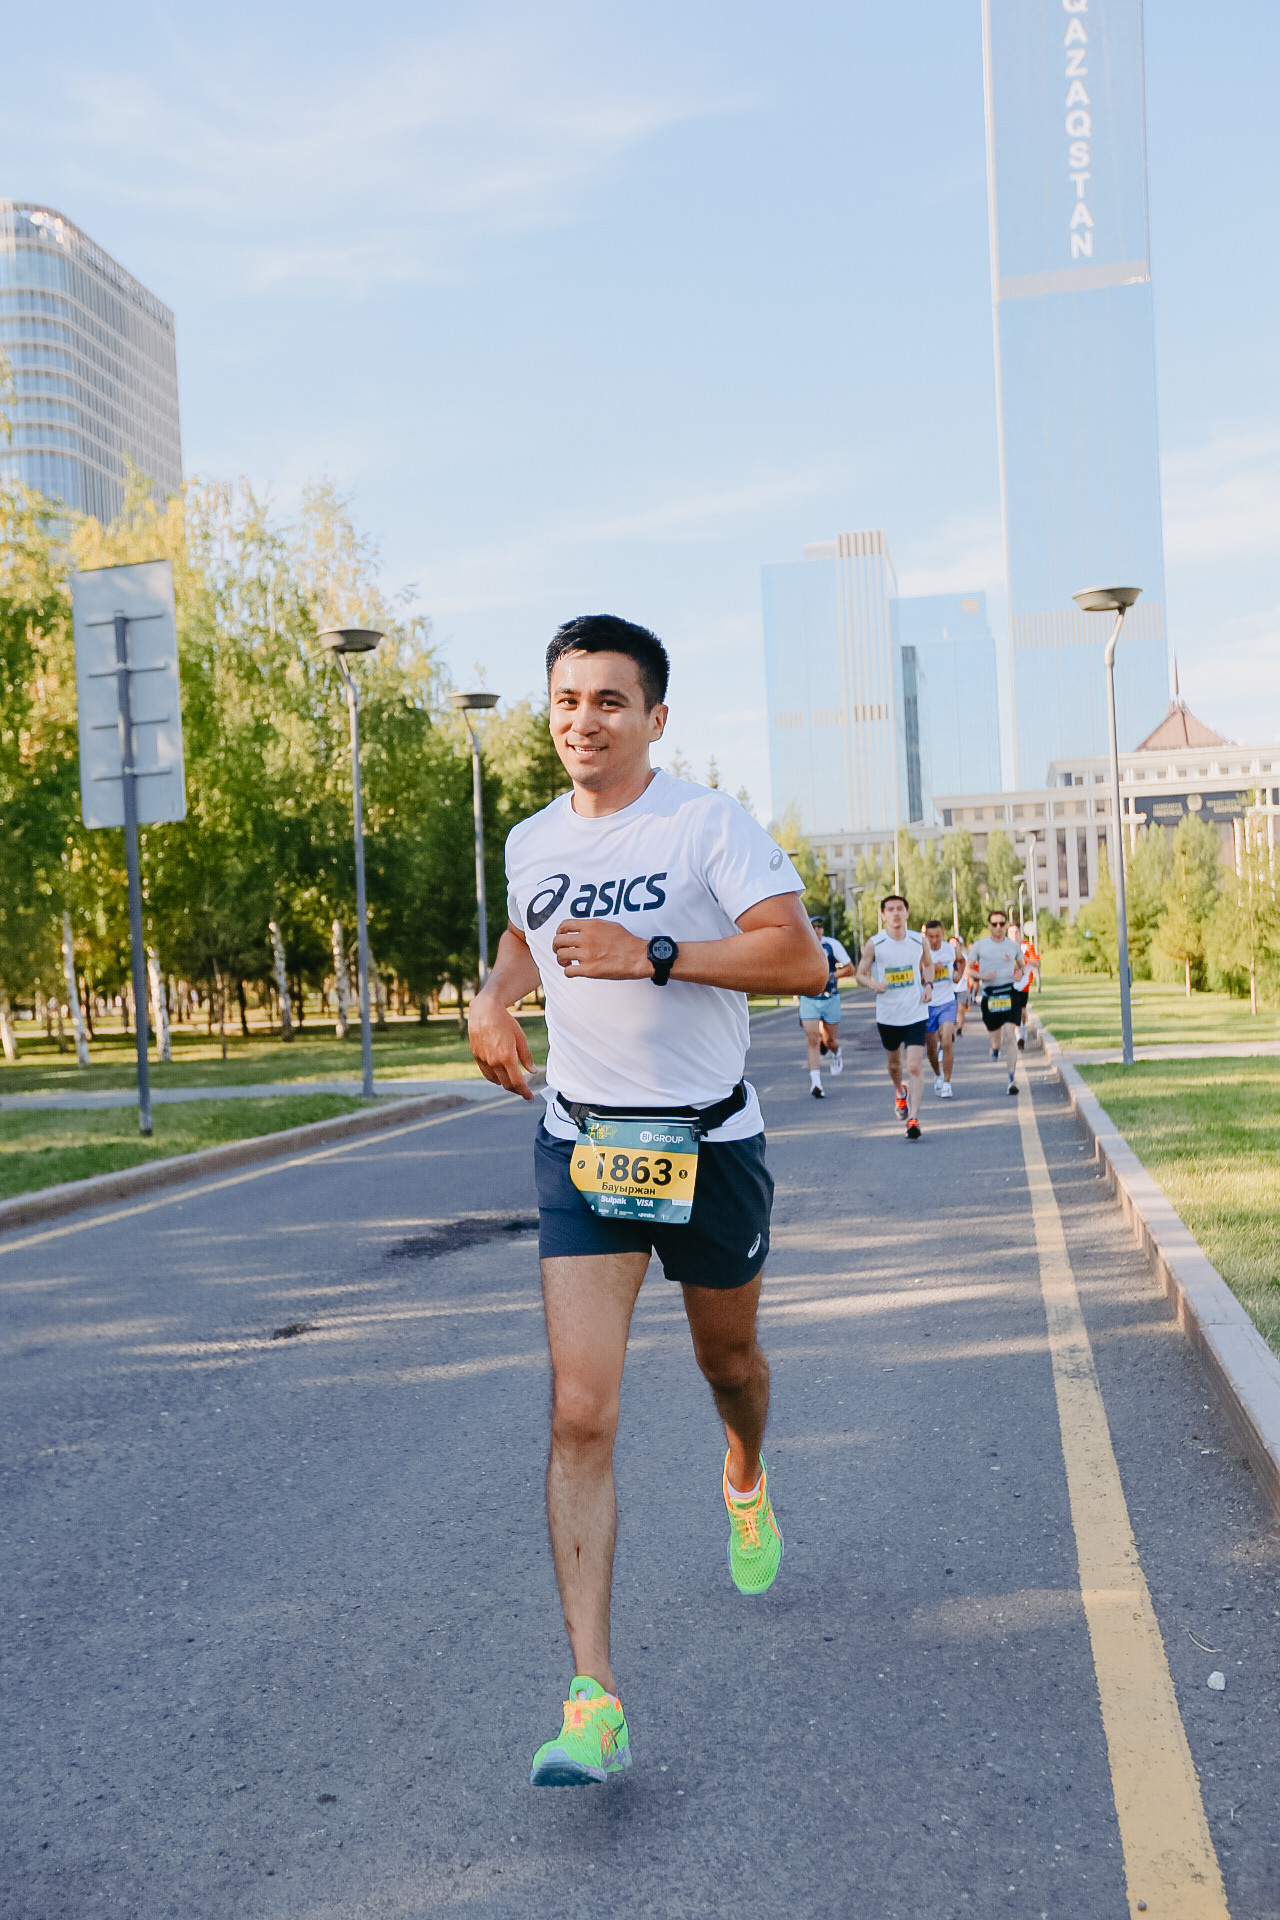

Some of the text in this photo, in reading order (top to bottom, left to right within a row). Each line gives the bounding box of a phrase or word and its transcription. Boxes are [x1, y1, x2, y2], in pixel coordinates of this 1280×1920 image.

[653, 1134, 684, 1144] GROUP
[595, 1153, 673, 1186] 1863
[602, 1182, 656, 1196] Бауыржан
[601, 1196, 654, 1208] Sulpak VISA
